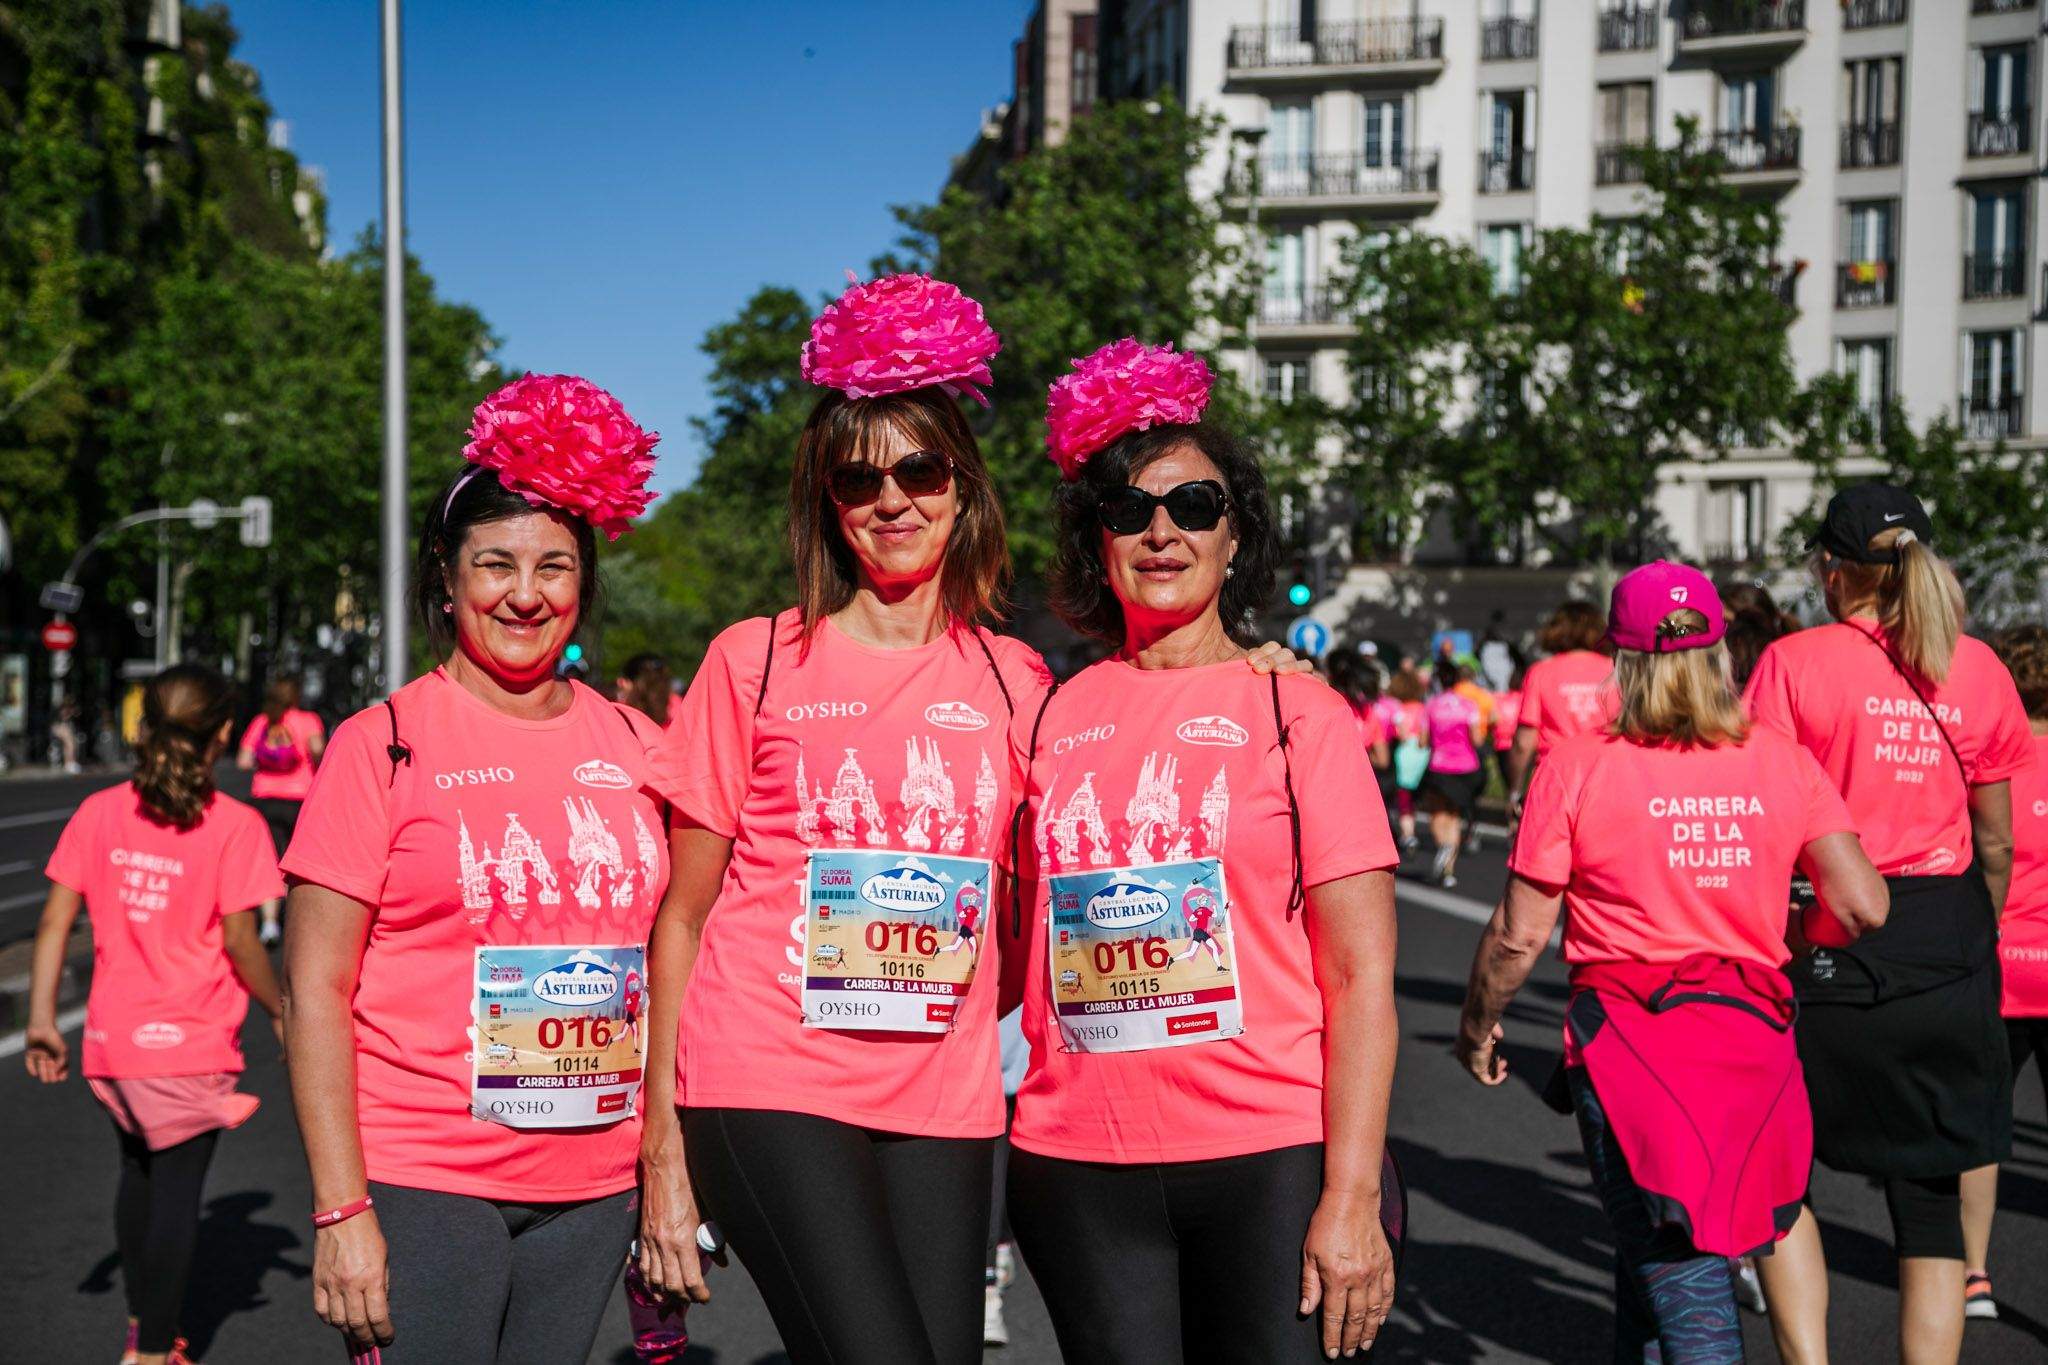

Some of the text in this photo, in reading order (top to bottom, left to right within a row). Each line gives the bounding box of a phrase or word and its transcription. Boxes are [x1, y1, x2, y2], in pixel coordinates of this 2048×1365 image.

[786, 701, 868, 722] OYSHO
[1866, 696, 1963, 726] CARRERA
[1883, 720, 1940, 744] DE LA
[1875, 742, 1942, 767] MUJER
[435, 766, 515, 790] OYSHO
[1648, 796, 1765, 818] CARRERA
[1673, 822, 1744, 843] DE LA
[1668, 846, 1752, 869] MUJER
[820, 875, 852, 886] SUMA
[1695, 874, 1729, 889] 2022
[868, 882, 940, 903] ASTURIANA
[1091, 901, 1164, 920] ASTURIANA
[865, 921, 938, 956] 016
[1093, 936, 1170, 974] 016
[880, 960, 925, 978] 10116
[540, 979, 614, 996] ASTURIANA
[844, 978, 953, 995] CARRERA DE LA MUJER
[1110, 977, 1160, 996] 10115
[819, 1001, 881, 1017] OYSHO
[1084, 993, 1195, 1014] CARRERA DE LA MUJER
[538, 1016, 611, 1050] 016
[1072, 1025, 1119, 1041] OYSHO
[1181, 1018, 1212, 1030] Santander
[554, 1056, 599, 1073] 10114
[516, 1073, 620, 1088] CARRERA DE LA MUJER
[490, 1100, 554, 1115] OYSHO
